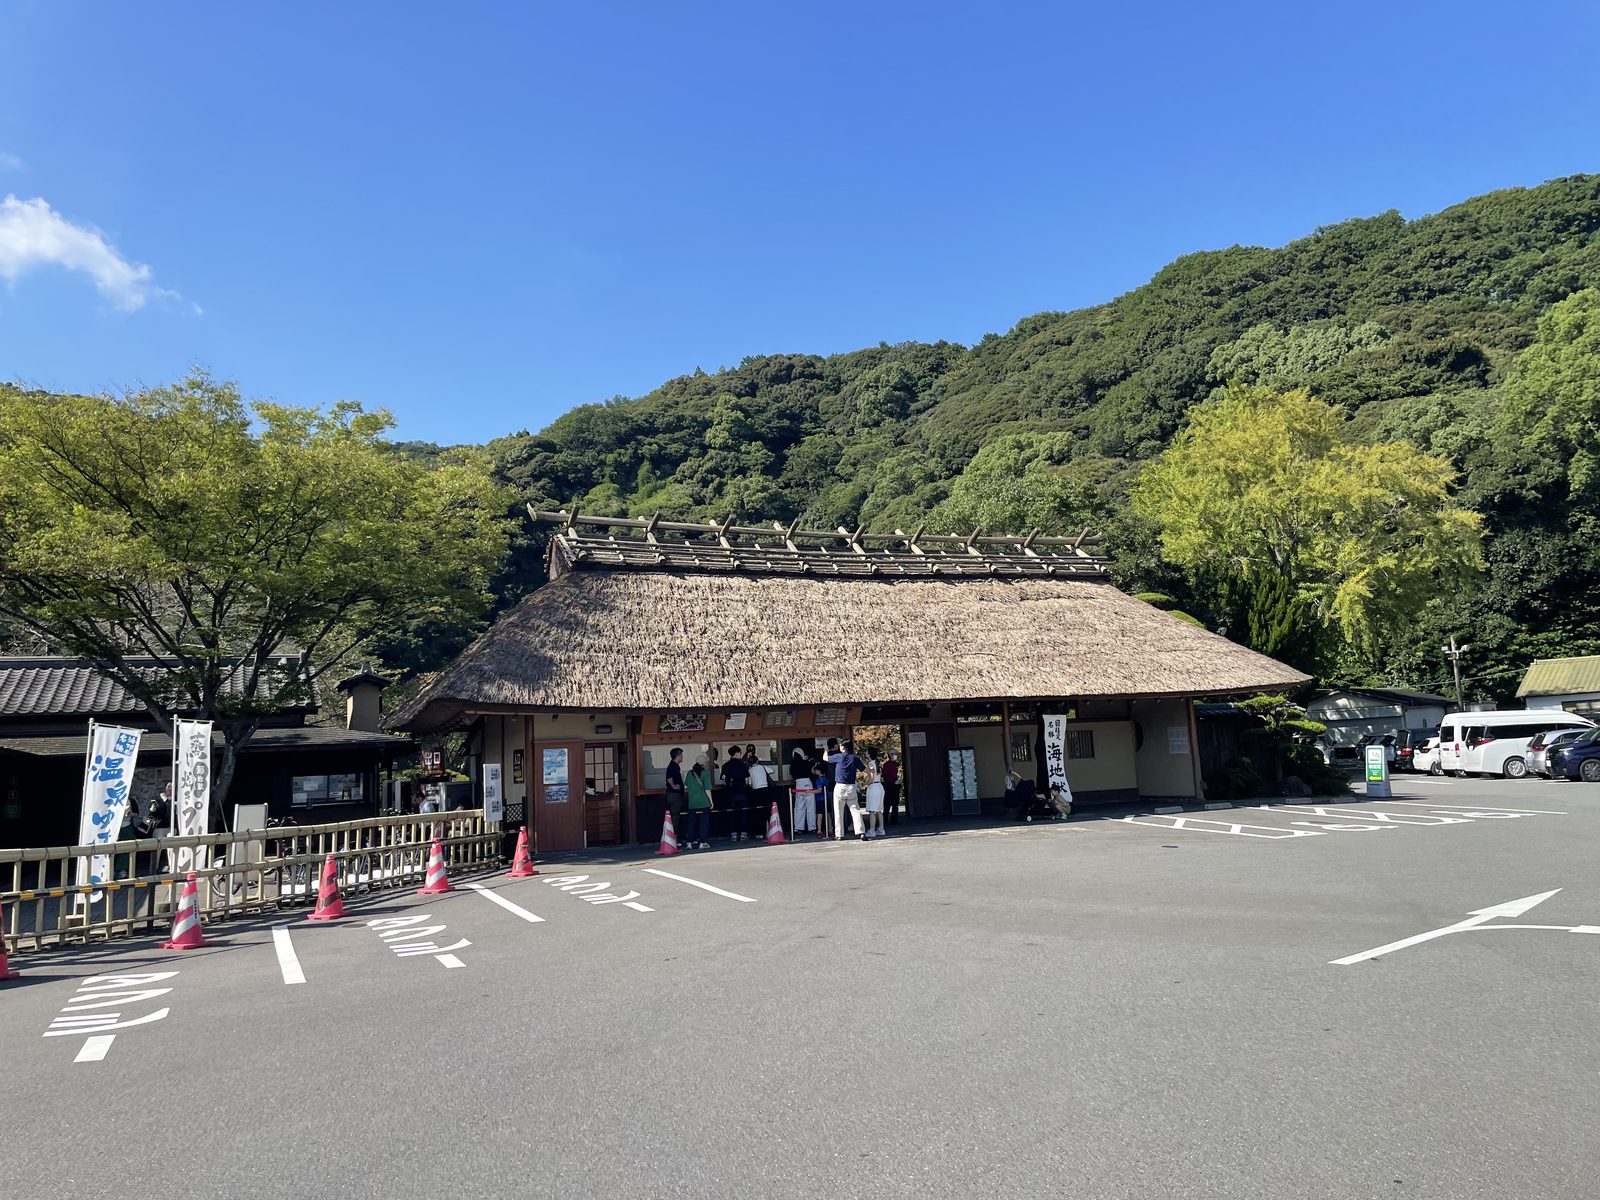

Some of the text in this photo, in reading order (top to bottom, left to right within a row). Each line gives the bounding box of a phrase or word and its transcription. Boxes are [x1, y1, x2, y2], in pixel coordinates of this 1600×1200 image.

[424, 751, 441, 765] 出口
[1047, 742, 1067, 793] 海地獄
[542, 875, 656, 912] タクシー
[366, 914, 473, 969] タクシー
[42, 971, 180, 1063] タクシー
